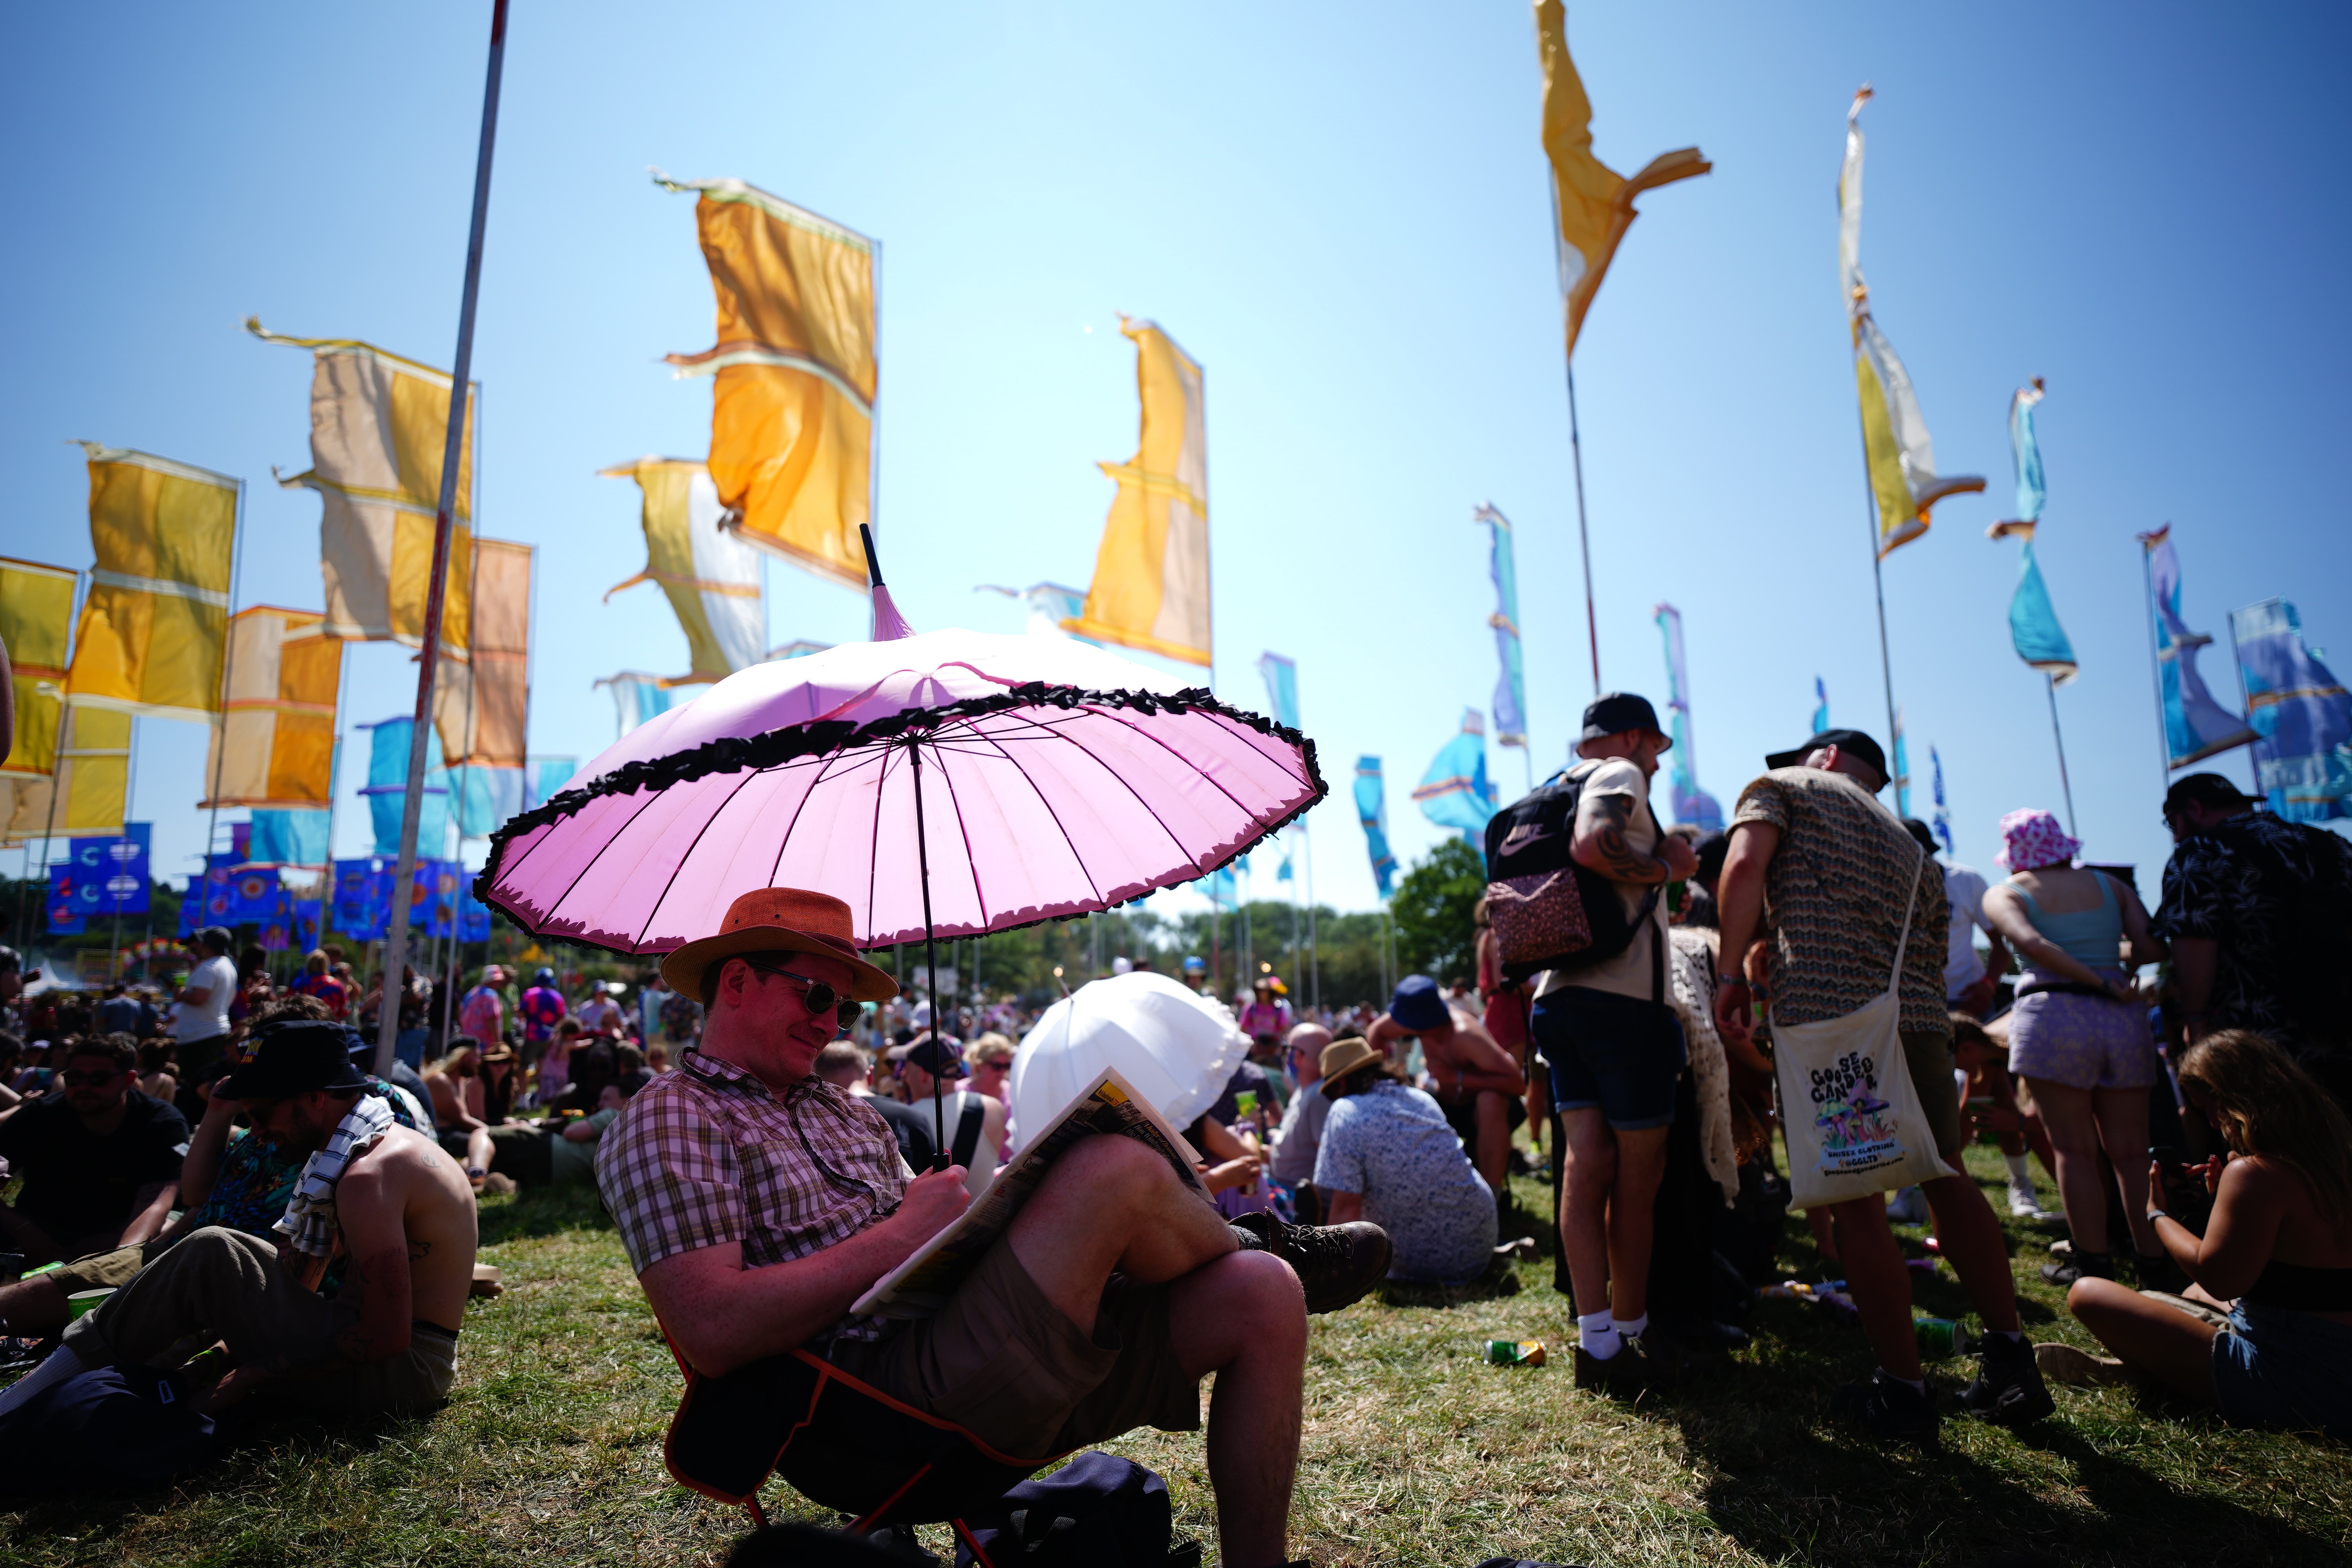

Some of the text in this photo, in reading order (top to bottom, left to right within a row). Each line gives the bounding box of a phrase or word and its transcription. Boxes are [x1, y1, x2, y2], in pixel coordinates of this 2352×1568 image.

[1506, 822, 1544, 843] NIKE
[1811, 1051, 1859, 1086] GOOSE
[1811, 1064, 1877, 1103] GANDER
[1828, 1141, 1895, 1158] UNISEX CLOTHING
